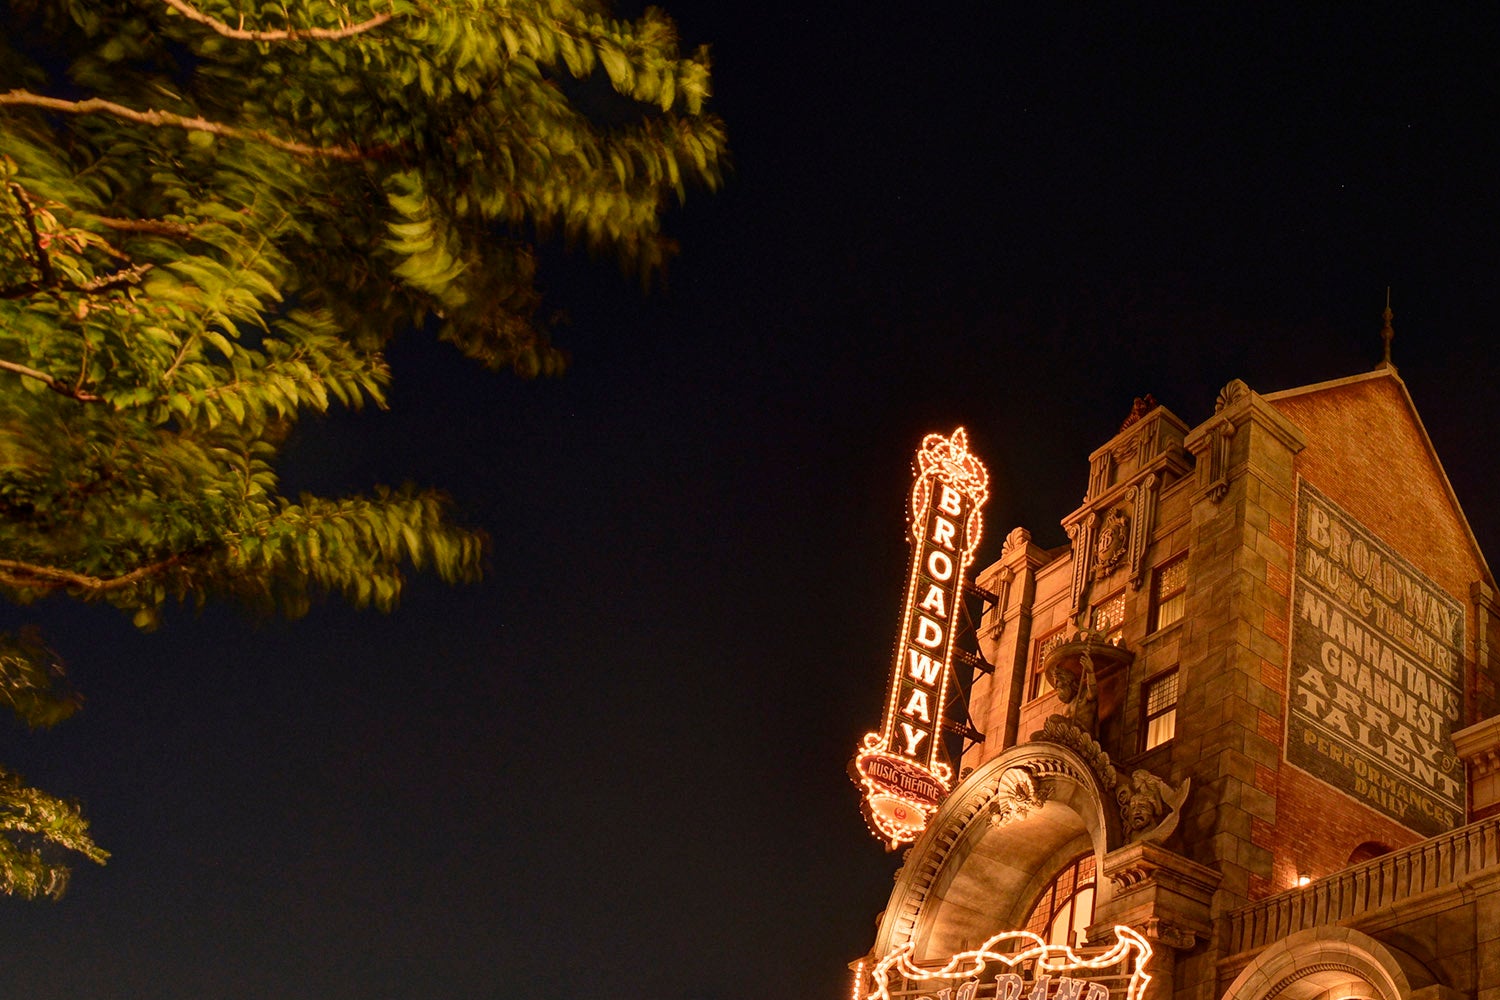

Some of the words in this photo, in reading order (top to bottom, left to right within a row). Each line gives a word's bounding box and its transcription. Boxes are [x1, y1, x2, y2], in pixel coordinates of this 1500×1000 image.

[901, 484, 962, 756] BROADWAY
[1306, 501, 1458, 646] BROADWAY
[1306, 548, 1373, 617] MUSIC
[1373, 597, 1459, 680] THEATRE
[1301, 591, 1459, 721] MANHATTAN'S
[1321, 641, 1444, 742] GRANDEST
[1298, 664, 1443, 764] ARRAY
[1298, 685, 1460, 799] TALENT
[868, 761, 898, 785] MUSIC
[900, 773, 940, 801] THEATRE
[1304, 729, 1455, 827] PERFORMANCES
[1355, 777, 1409, 817] DAILY
